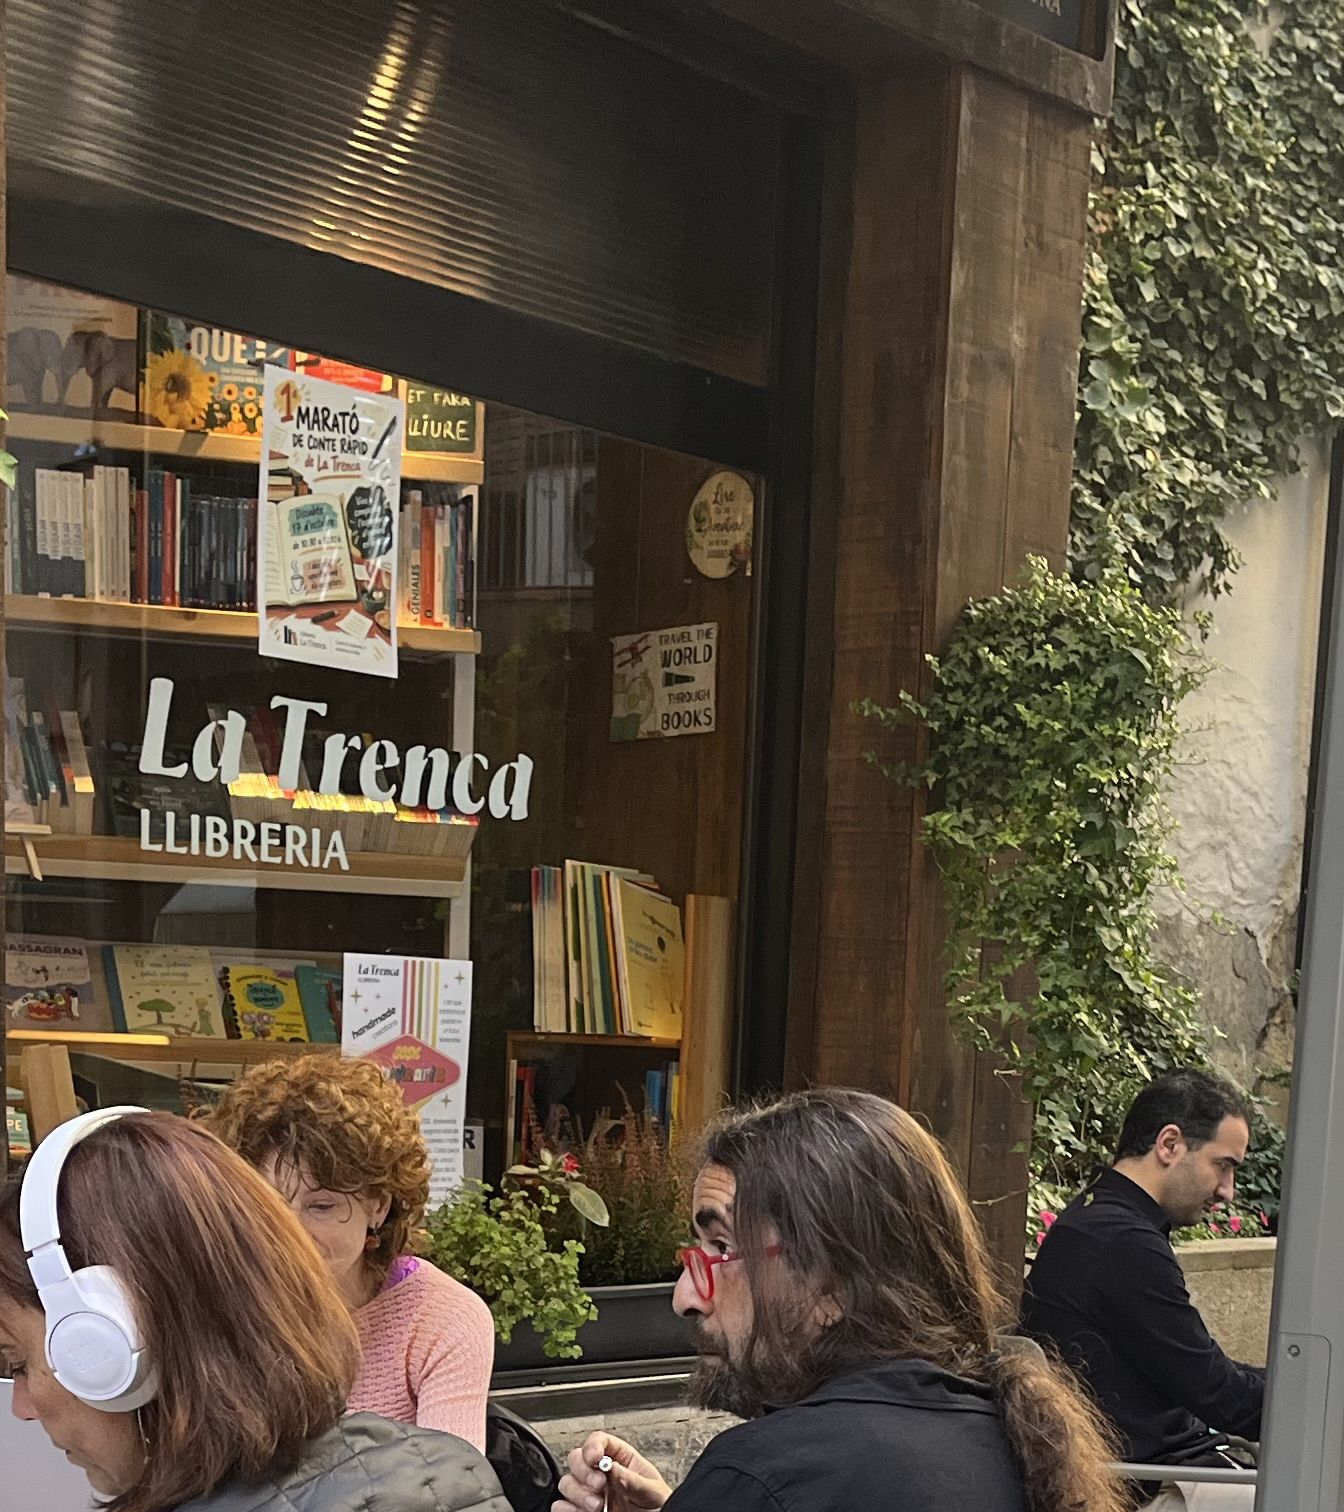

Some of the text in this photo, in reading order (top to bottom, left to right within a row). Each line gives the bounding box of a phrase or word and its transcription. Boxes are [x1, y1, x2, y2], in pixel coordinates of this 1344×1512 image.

[296, 403, 359, 435] MARATÓ
[292, 433, 368, 456] DE CONTE RÀPID
[304, 454, 362, 472] de La Trenca
[411, 564, 420, 615] GENIALES
[659, 628, 714, 645] TRAVEL THE
[661, 644, 712, 668] WORLD
[668, 689, 710, 704] THROUGH
[661, 707, 712, 731] BOOKS
[138, 677, 534, 821] La Trenca
[140, 808, 350, 871] LLIBRERIA
[6, 943, 83, 956] ASSAGRAN
[358, 964, 369, 975] La
[352, 1007, 396, 1040] handmade
